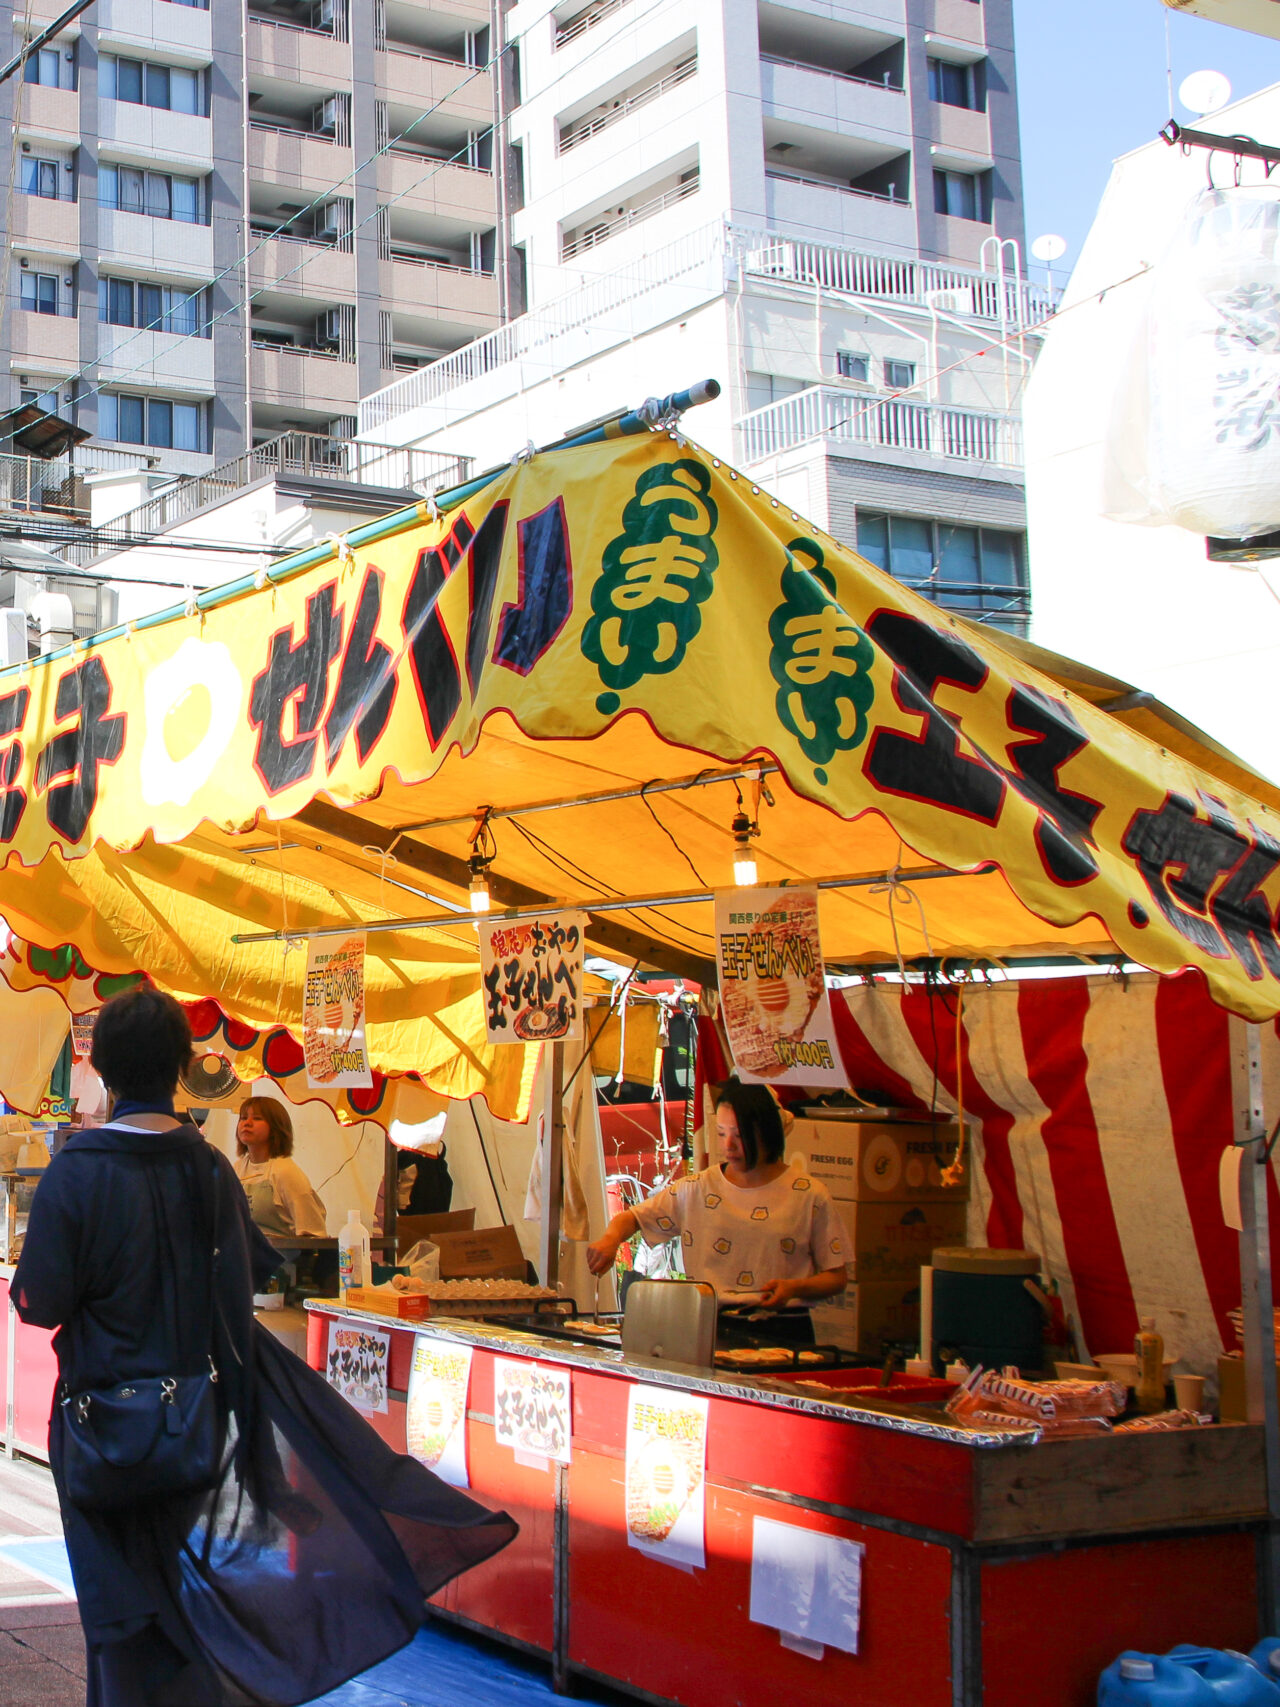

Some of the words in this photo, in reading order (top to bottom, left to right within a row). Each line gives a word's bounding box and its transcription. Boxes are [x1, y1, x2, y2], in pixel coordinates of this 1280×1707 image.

[720, 931, 816, 981] 玉子せんべい
[305, 966, 362, 1007] 玉子せんべい
[484, 955, 581, 1032] 玉子せんべい
[810, 1154, 835, 1165] FRESH
[837, 1156, 854, 1167] EGG
[632, 1403, 704, 1440] 玉子せんべい
